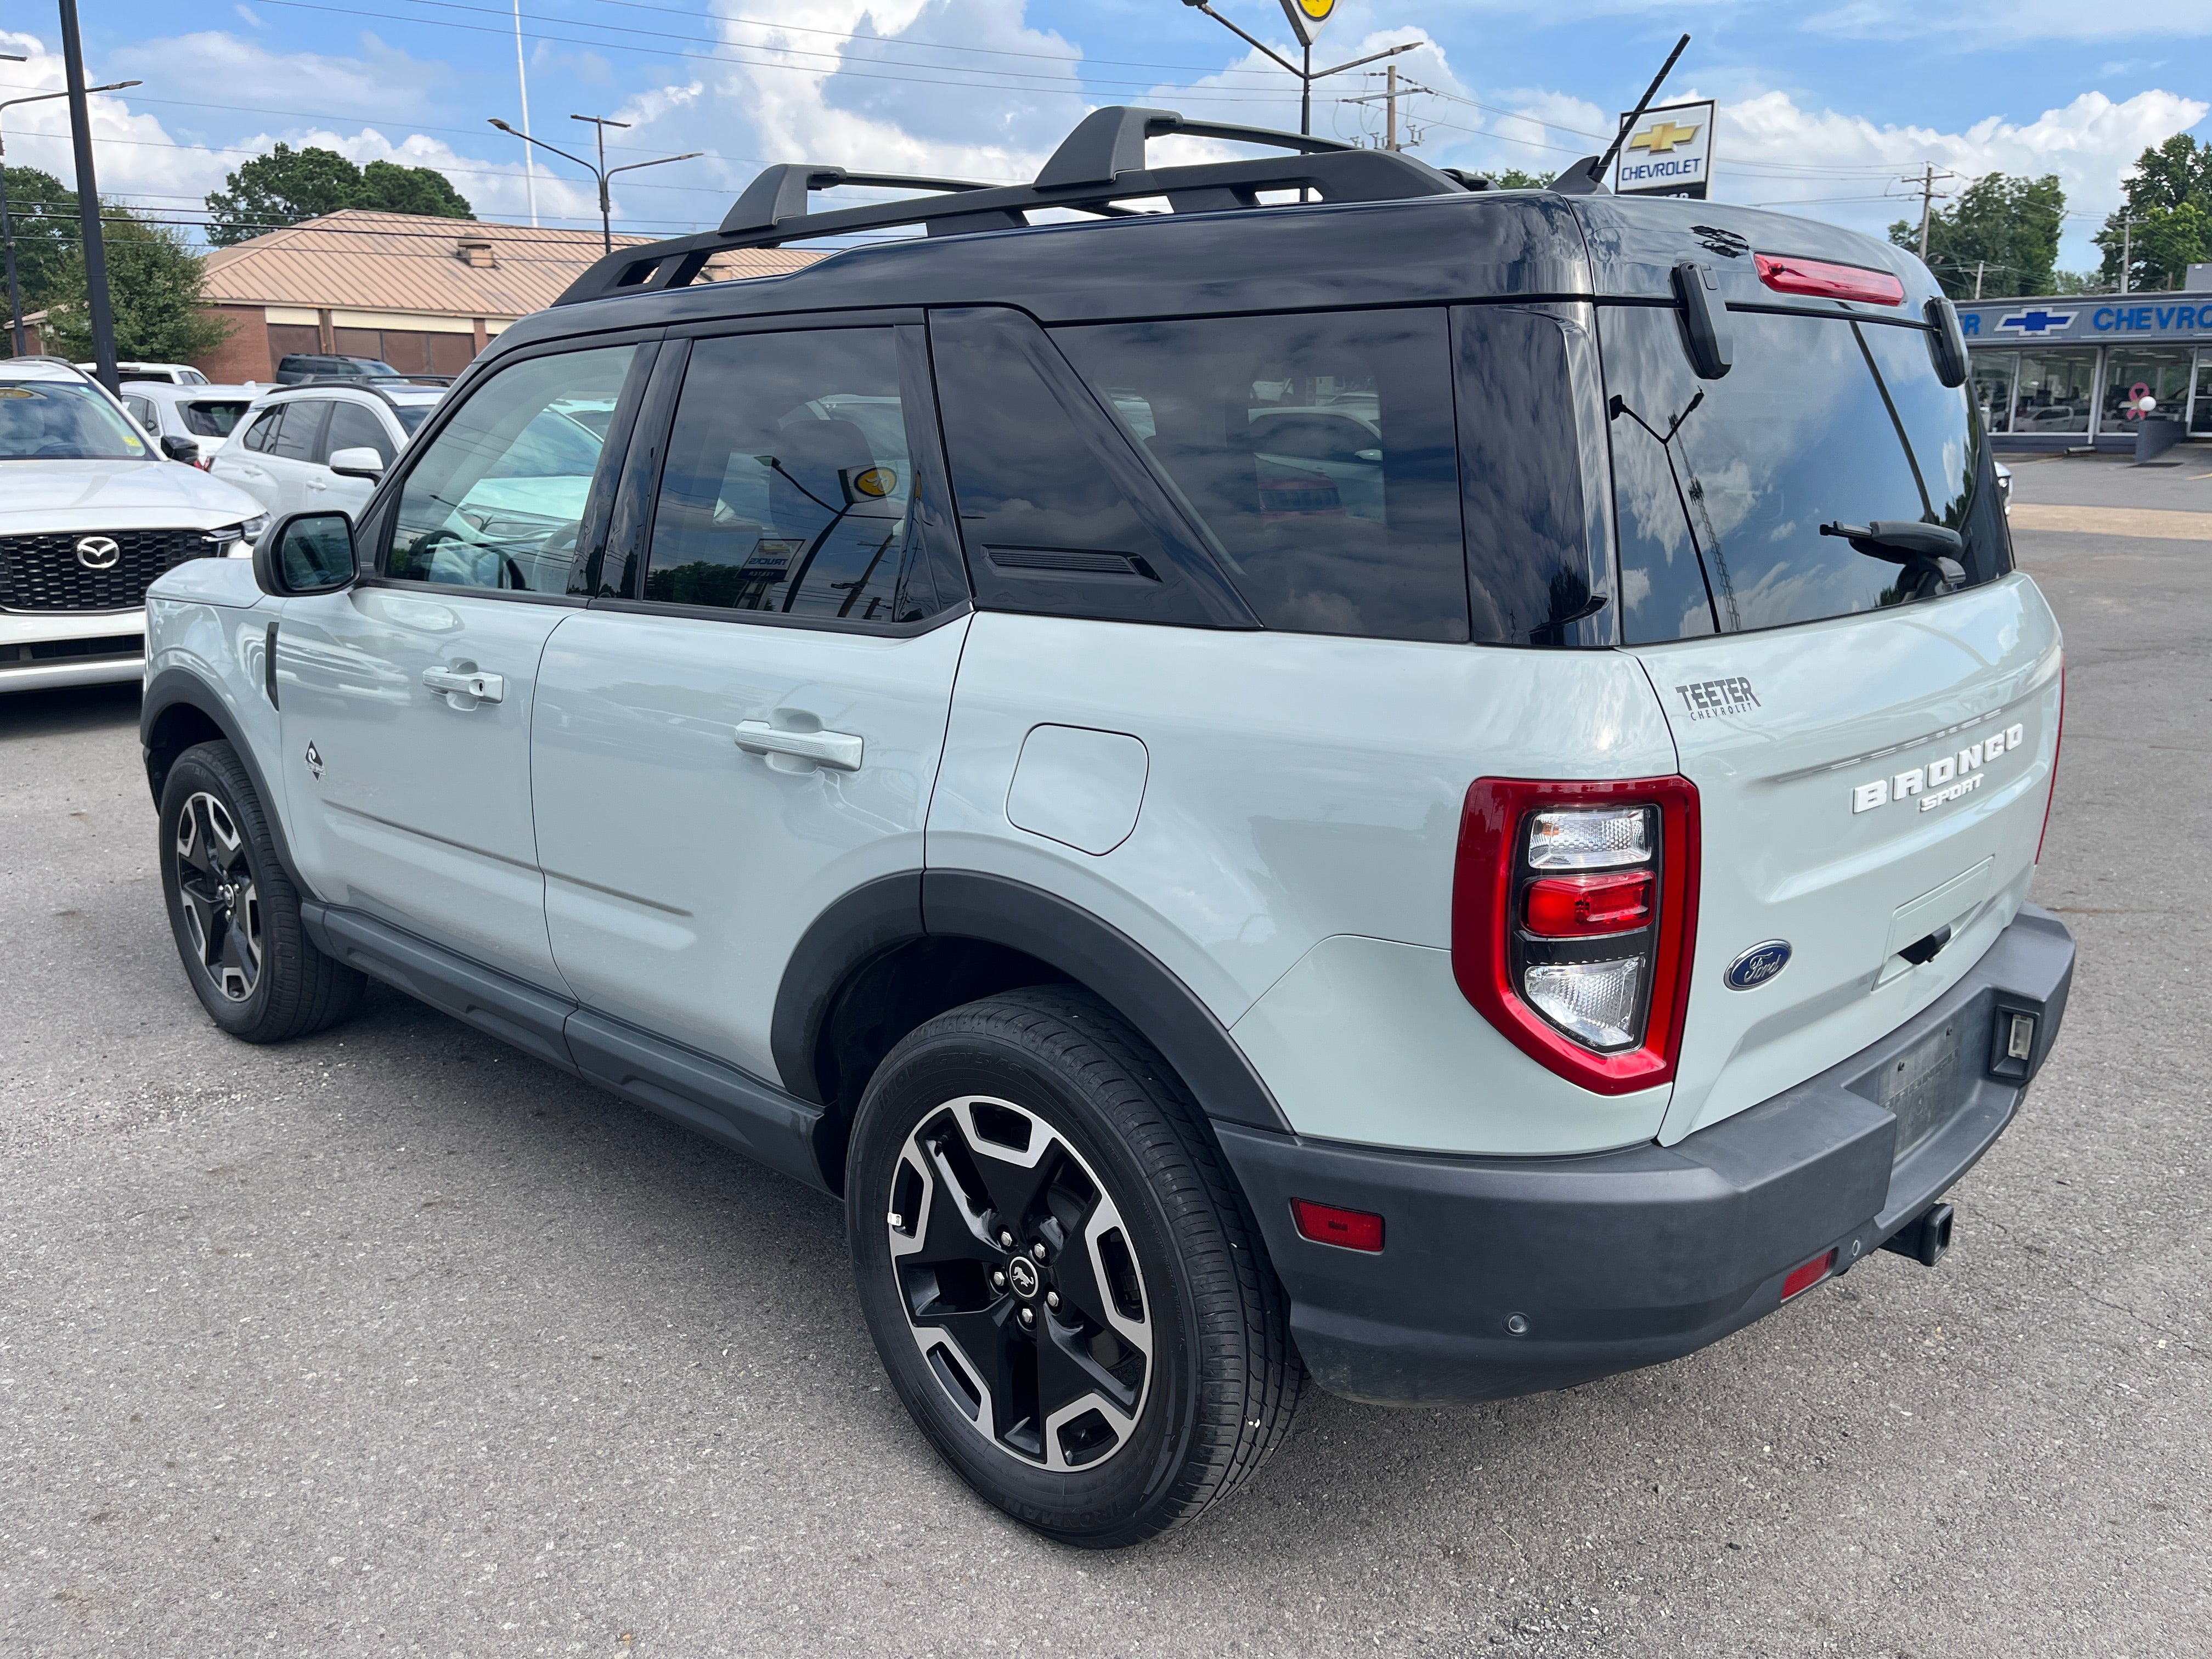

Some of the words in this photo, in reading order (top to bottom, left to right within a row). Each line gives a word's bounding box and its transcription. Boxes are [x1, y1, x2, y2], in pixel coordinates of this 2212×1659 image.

[1622, 158, 1701, 180] CHEVROLET
[1675, 676, 1762, 711] TEETER
[1690, 702, 1752, 721] CHEVROLET
[1852, 723, 2023, 814] BRONCO
[1920, 772, 1985, 812] SPORT
[1743, 951, 1782, 983] Ford
